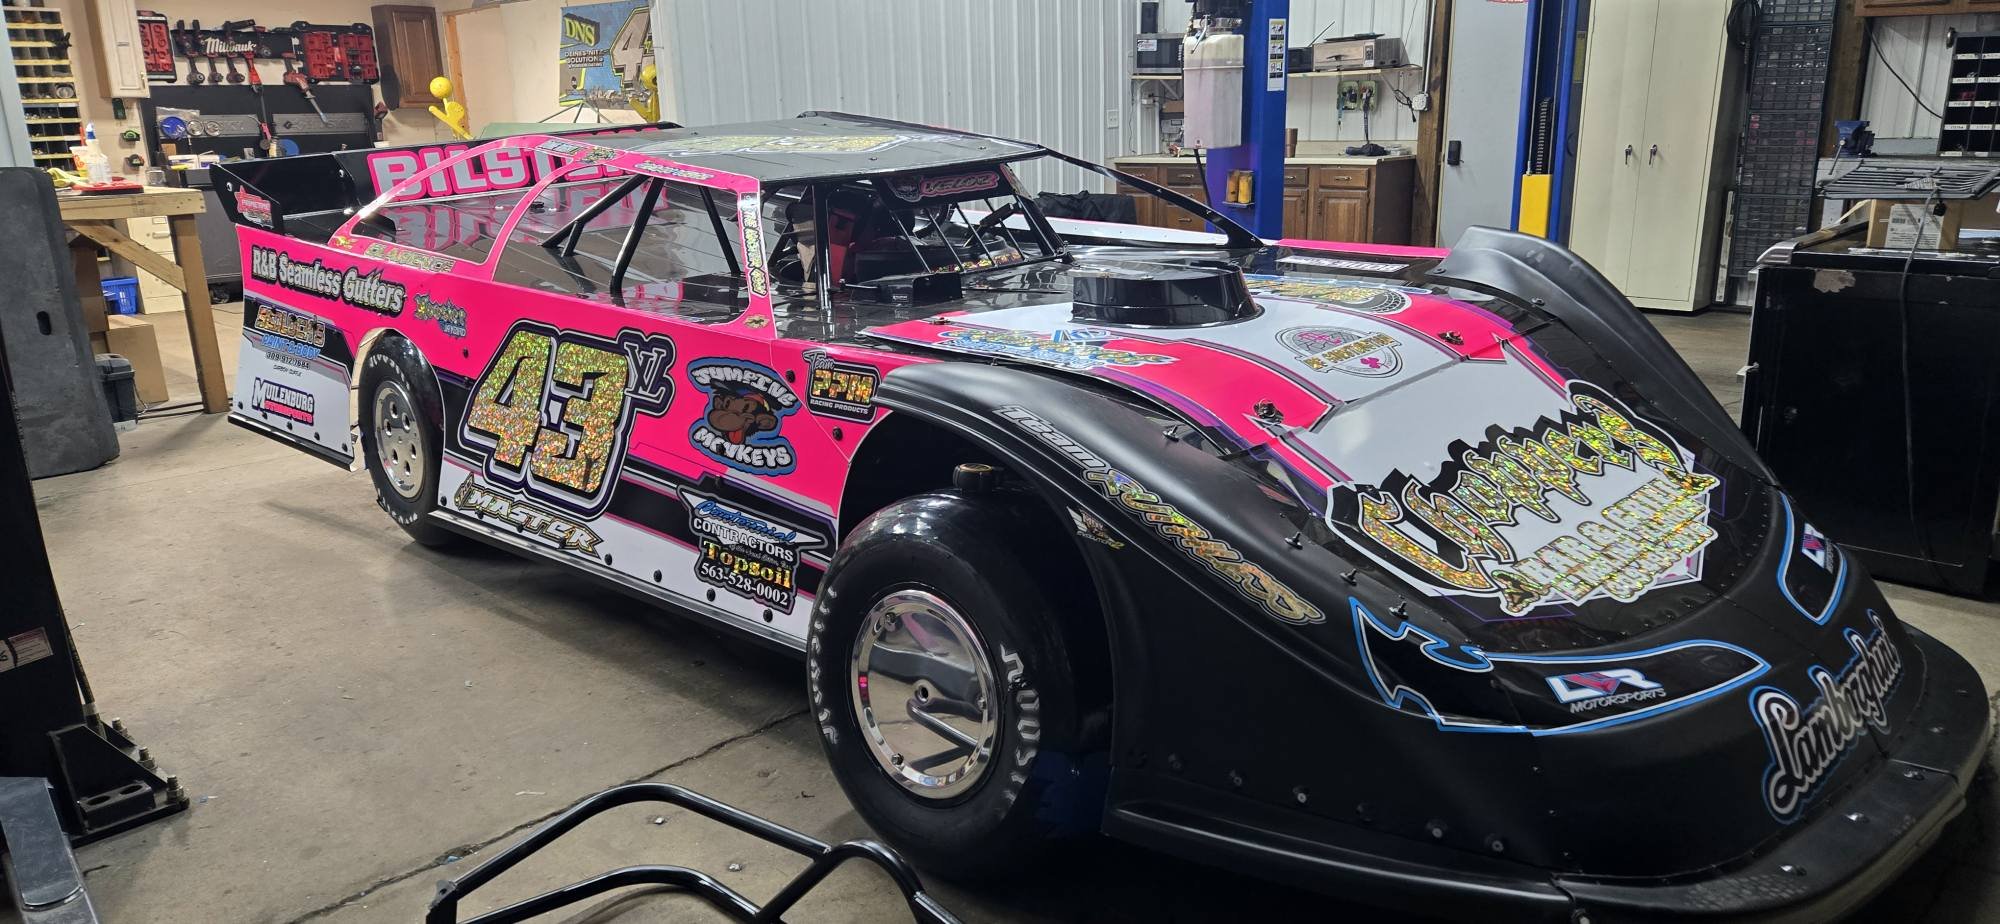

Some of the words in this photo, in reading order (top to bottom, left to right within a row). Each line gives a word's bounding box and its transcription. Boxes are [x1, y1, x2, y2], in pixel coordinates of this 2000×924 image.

[205, 37, 257, 54] Milauk
[564, 17, 595, 47] DNS
[252, 246, 277, 282] R&B
[278, 254, 343, 296] Seamless
[342, 267, 406, 312] Gutters
[261, 333, 288, 351] PAINT
[296, 341, 322, 360] BODY
[803, 350, 836, 370] Team
[252, 378, 314, 413] MUILENBURG
[692, 364, 801, 407] JUMPING
[810, 398, 834, 409] RACING
[835, 402, 870, 415] PRODUCTS
[811, 369, 875, 405] PPM
[464, 328, 631, 496] 43
[993, 404, 1106, 470] Team
[467, 488, 602, 557] MASTER
[693, 518, 795, 562] CONTRACTORS
[695, 500, 799, 545] Centennial
[702, 539, 793, 589] Topsoil
[1514, 534, 1590, 586] BAR
[1577, 520, 1618, 552] &
[699, 562, 789, 607] 563-528-0002
[1570, 687, 1667, 714] MOTORSPORTS
